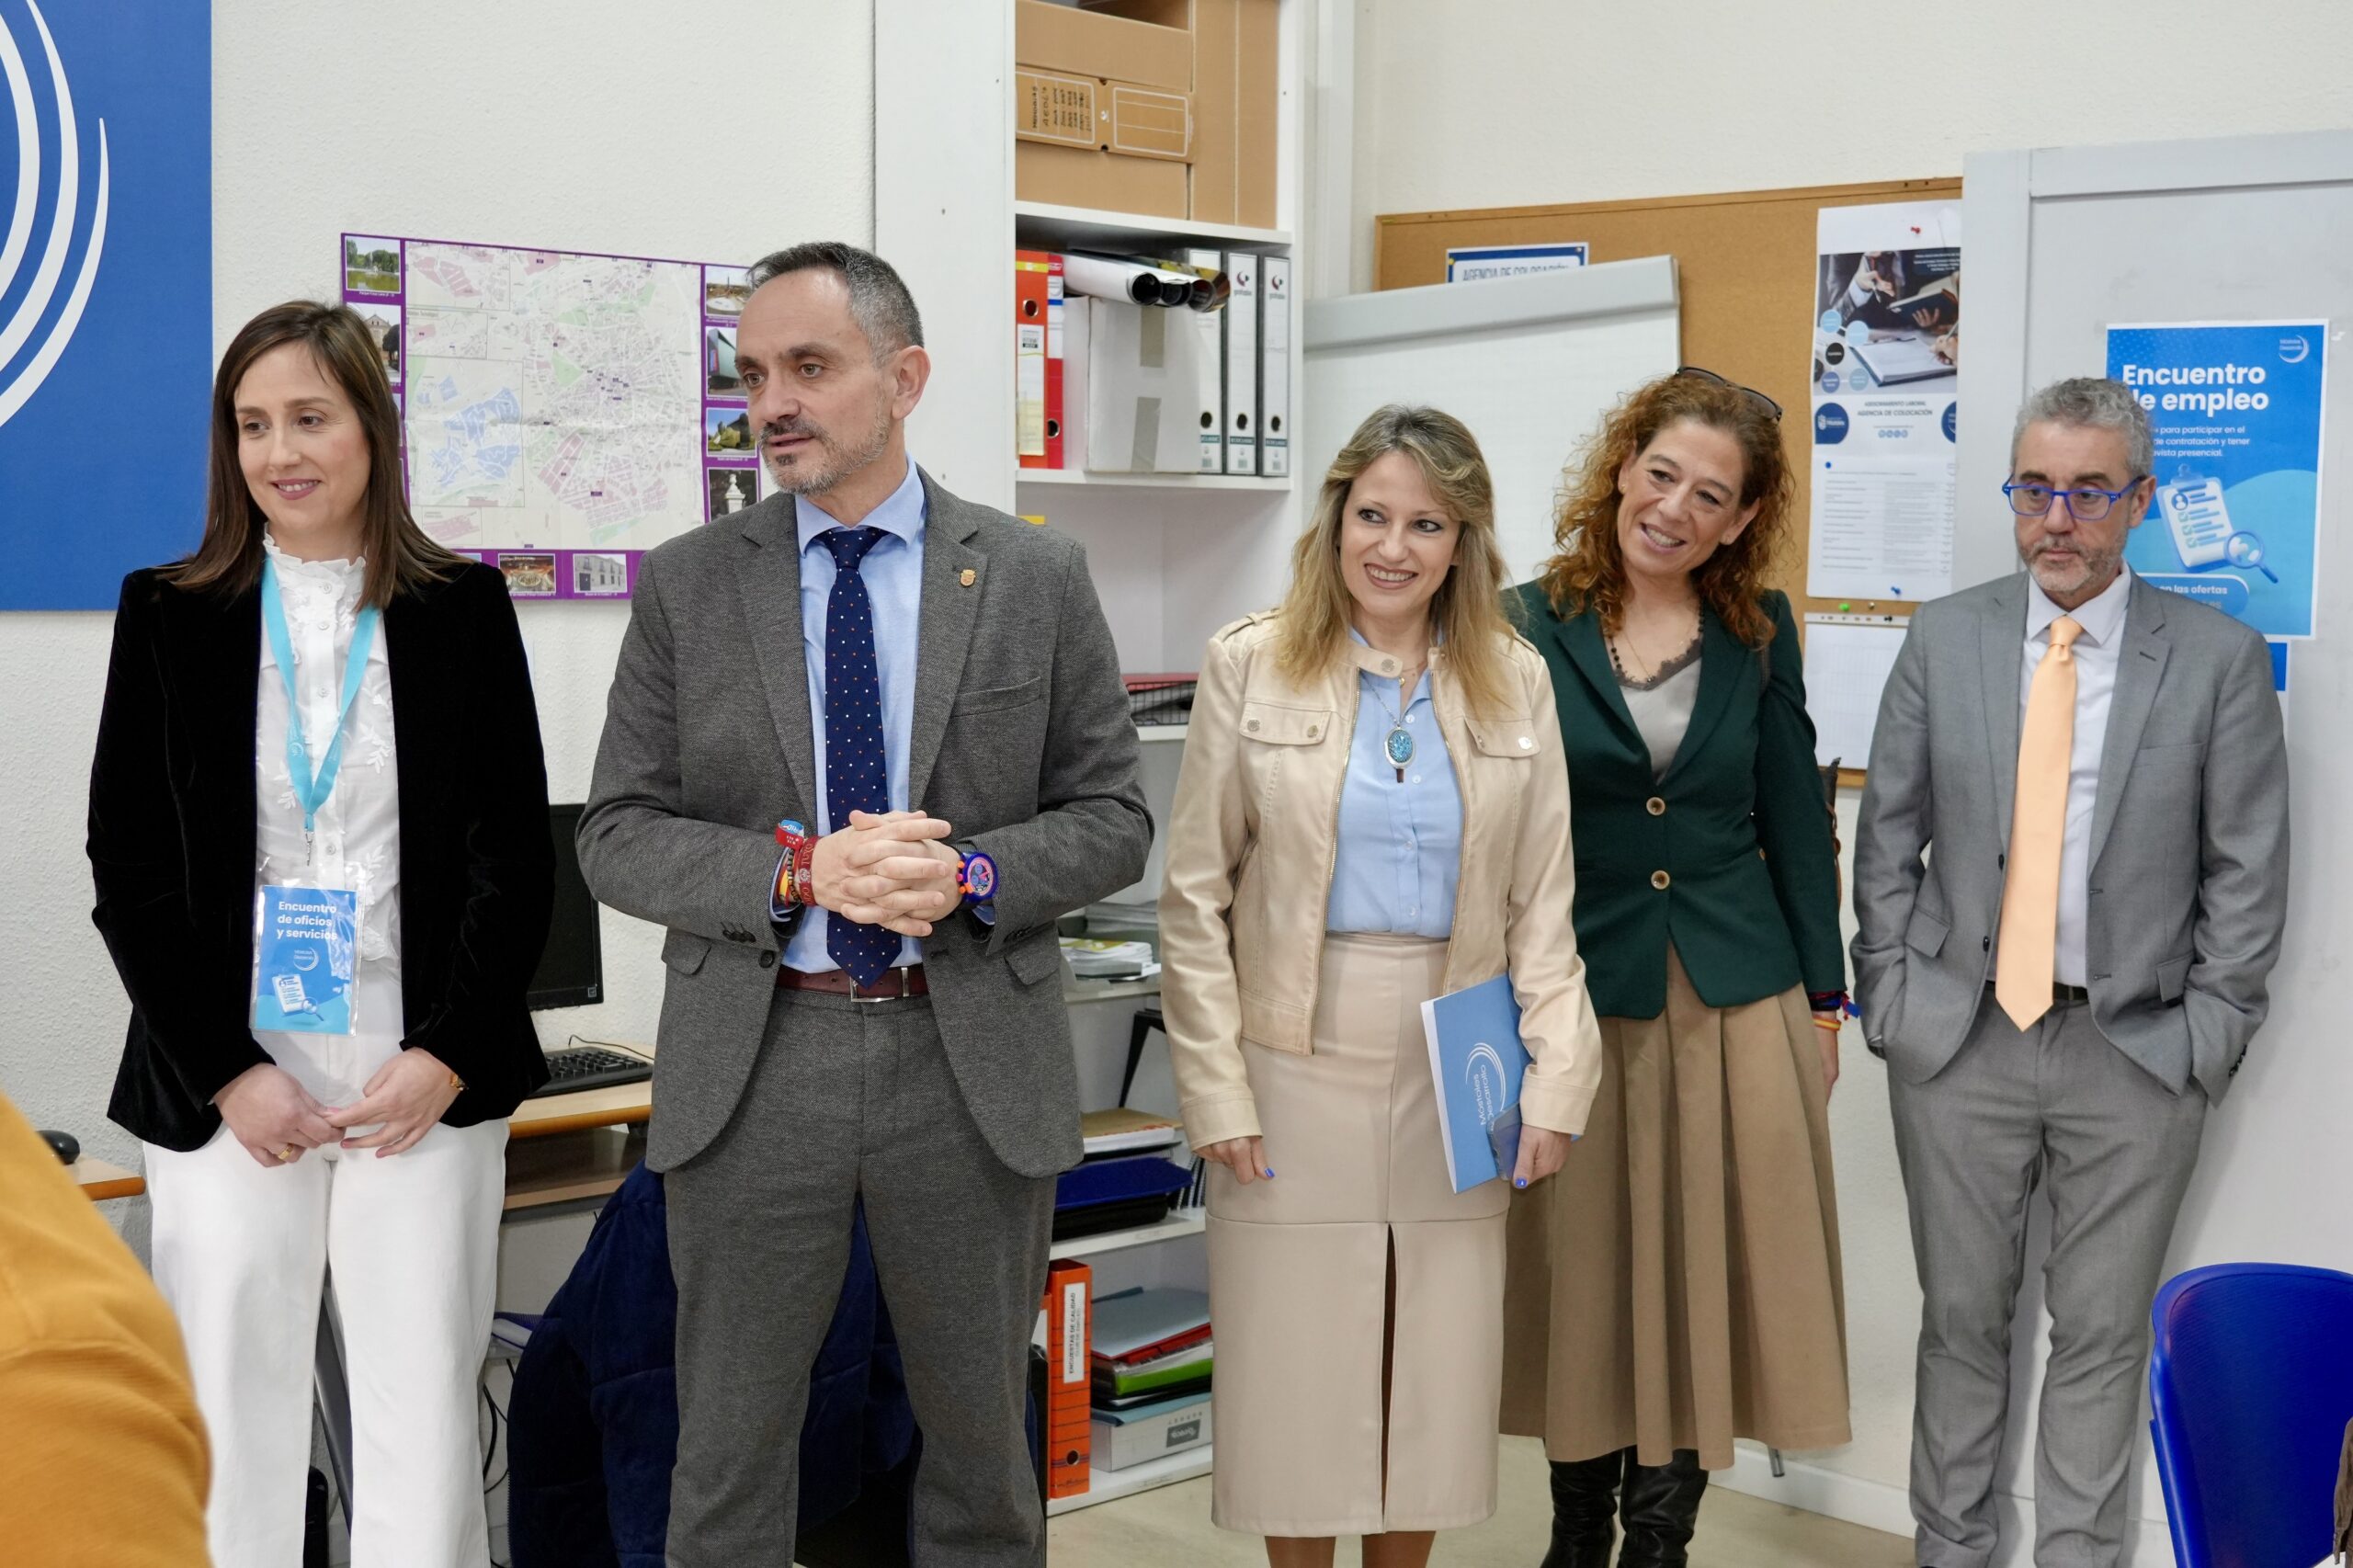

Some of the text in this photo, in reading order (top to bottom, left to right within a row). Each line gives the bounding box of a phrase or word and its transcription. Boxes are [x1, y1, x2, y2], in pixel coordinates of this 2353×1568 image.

[2122, 363, 2267, 386] Encuentro
[2161, 387, 2269, 417] empleo
[2160, 426, 2180, 436] para
[2182, 426, 2222, 436] participar
[2237, 426, 2245, 434] el
[2165, 437, 2219, 446] contratación
[2221, 438, 2226, 448] y
[2228, 437, 2250, 446] tener
[2174, 585, 2188, 595] las
[2190, 585, 2228, 595] ofertas
[278, 901, 337, 914] Encuentro
[278, 915, 333, 926] de oficios
[277, 928, 338, 940] y servicios
[1473, 1074, 1486, 1125] Móstoles
